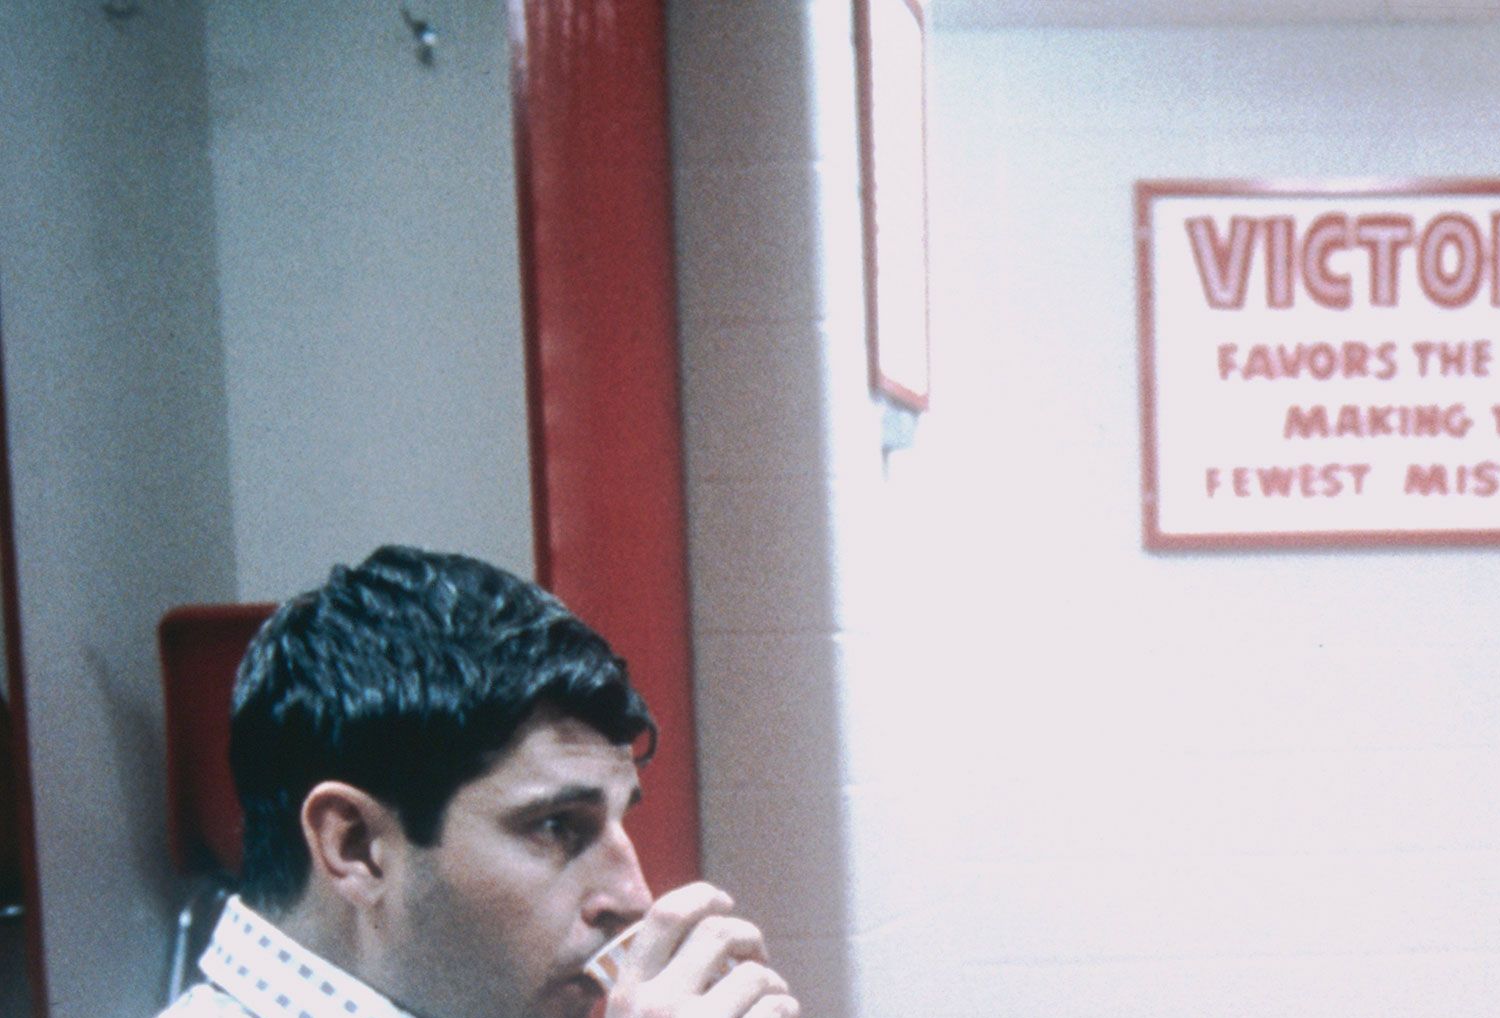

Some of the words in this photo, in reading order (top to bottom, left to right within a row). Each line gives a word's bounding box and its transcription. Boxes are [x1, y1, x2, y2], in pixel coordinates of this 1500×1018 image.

[1217, 341, 1398, 381] FAVORS
[1411, 340, 1492, 378] THE
[1283, 403, 1474, 440] MAKING
[1205, 462, 1371, 499] FEWEST
